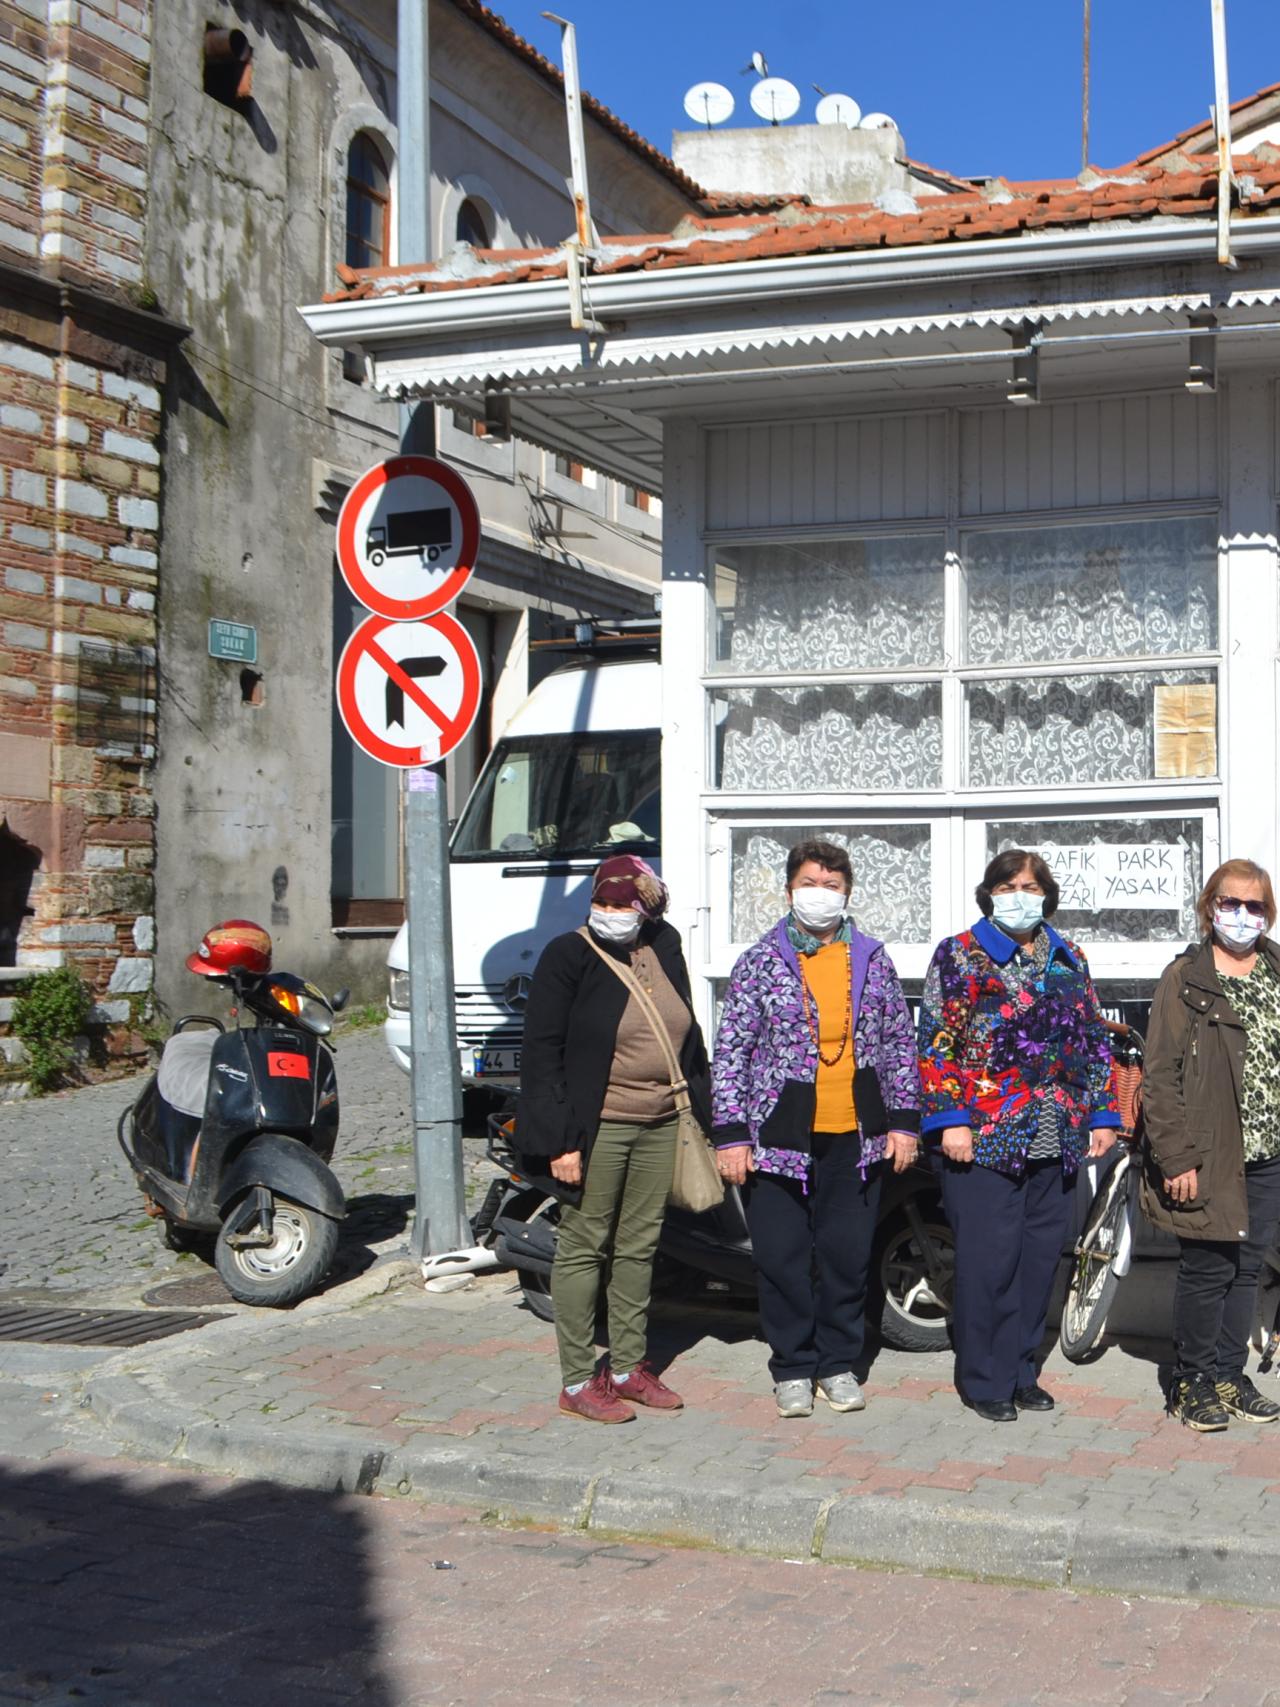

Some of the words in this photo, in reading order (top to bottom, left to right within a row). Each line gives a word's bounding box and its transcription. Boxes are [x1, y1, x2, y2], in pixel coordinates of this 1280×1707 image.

[1042, 848, 1096, 871] RAFİK
[1118, 848, 1173, 871] PARK
[1058, 887, 1096, 909] ZARI
[1105, 876, 1177, 899] YASAK!
[484, 1052, 503, 1069] 44
